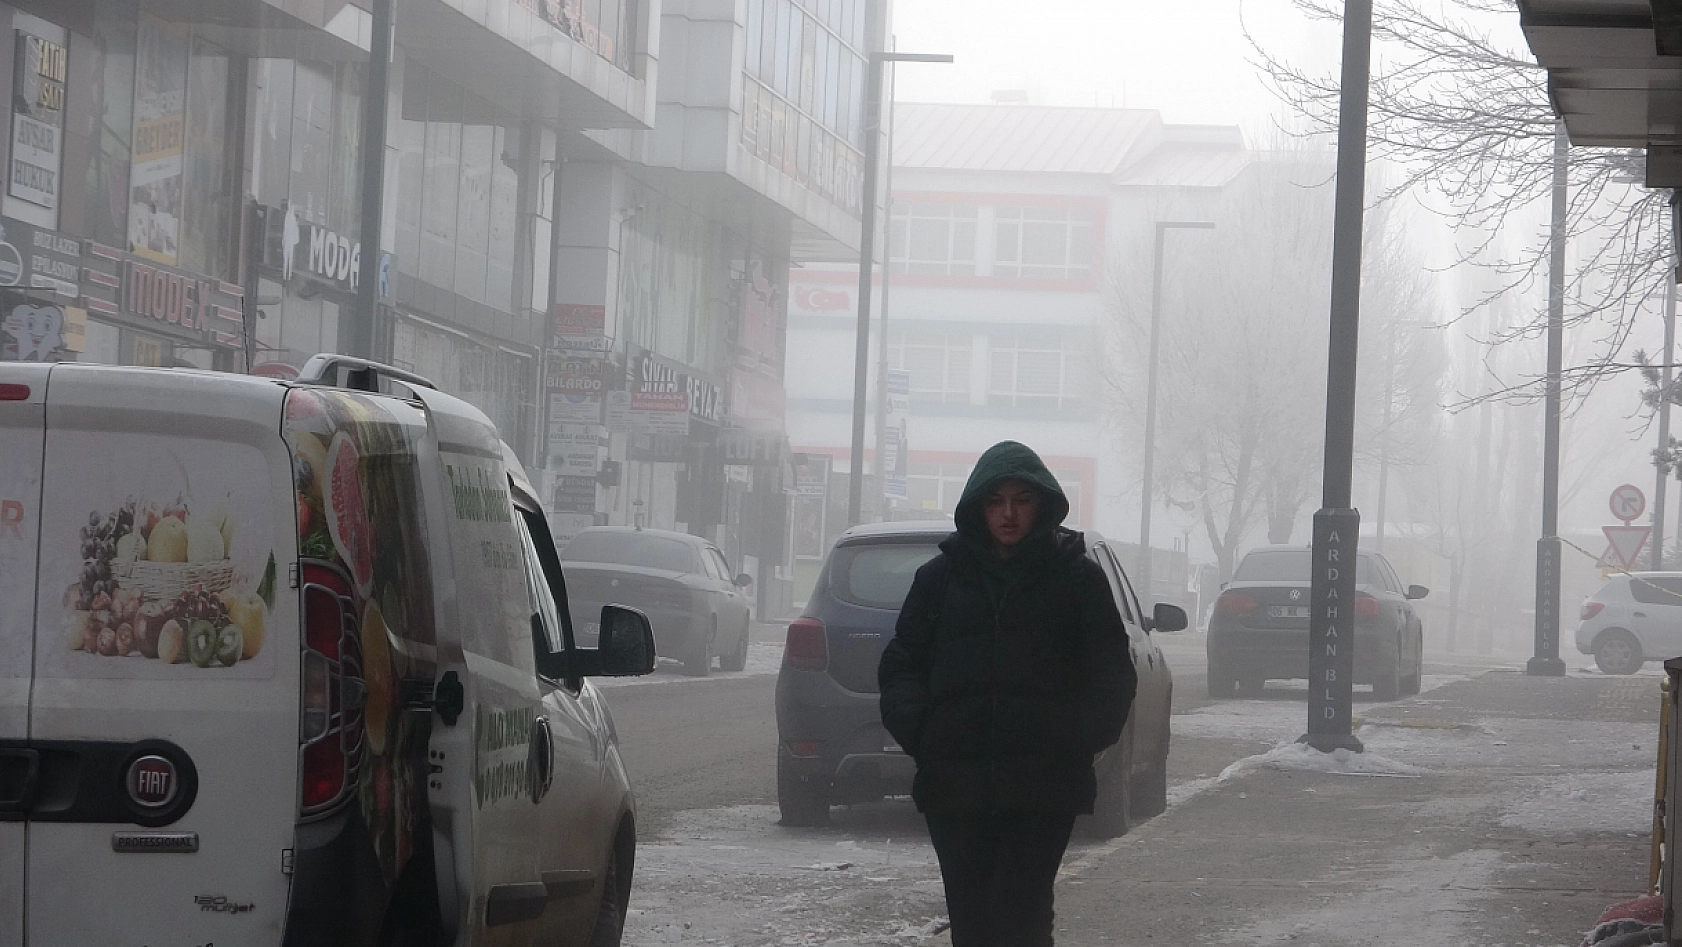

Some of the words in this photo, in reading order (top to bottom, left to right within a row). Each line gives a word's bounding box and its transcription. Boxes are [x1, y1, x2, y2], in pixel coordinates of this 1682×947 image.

[130, 263, 209, 331] MODEX
[634, 393, 683, 401] TAHAN
[687, 376, 722, 420] BEYAZ
[1326, 530, 1340, 657] ARDAHAN
[1323, 669, 1337, 720] BLD
[138, 770, 169, 795] FIAT
[118, 837, 193, 848] PROFESSIONAL
